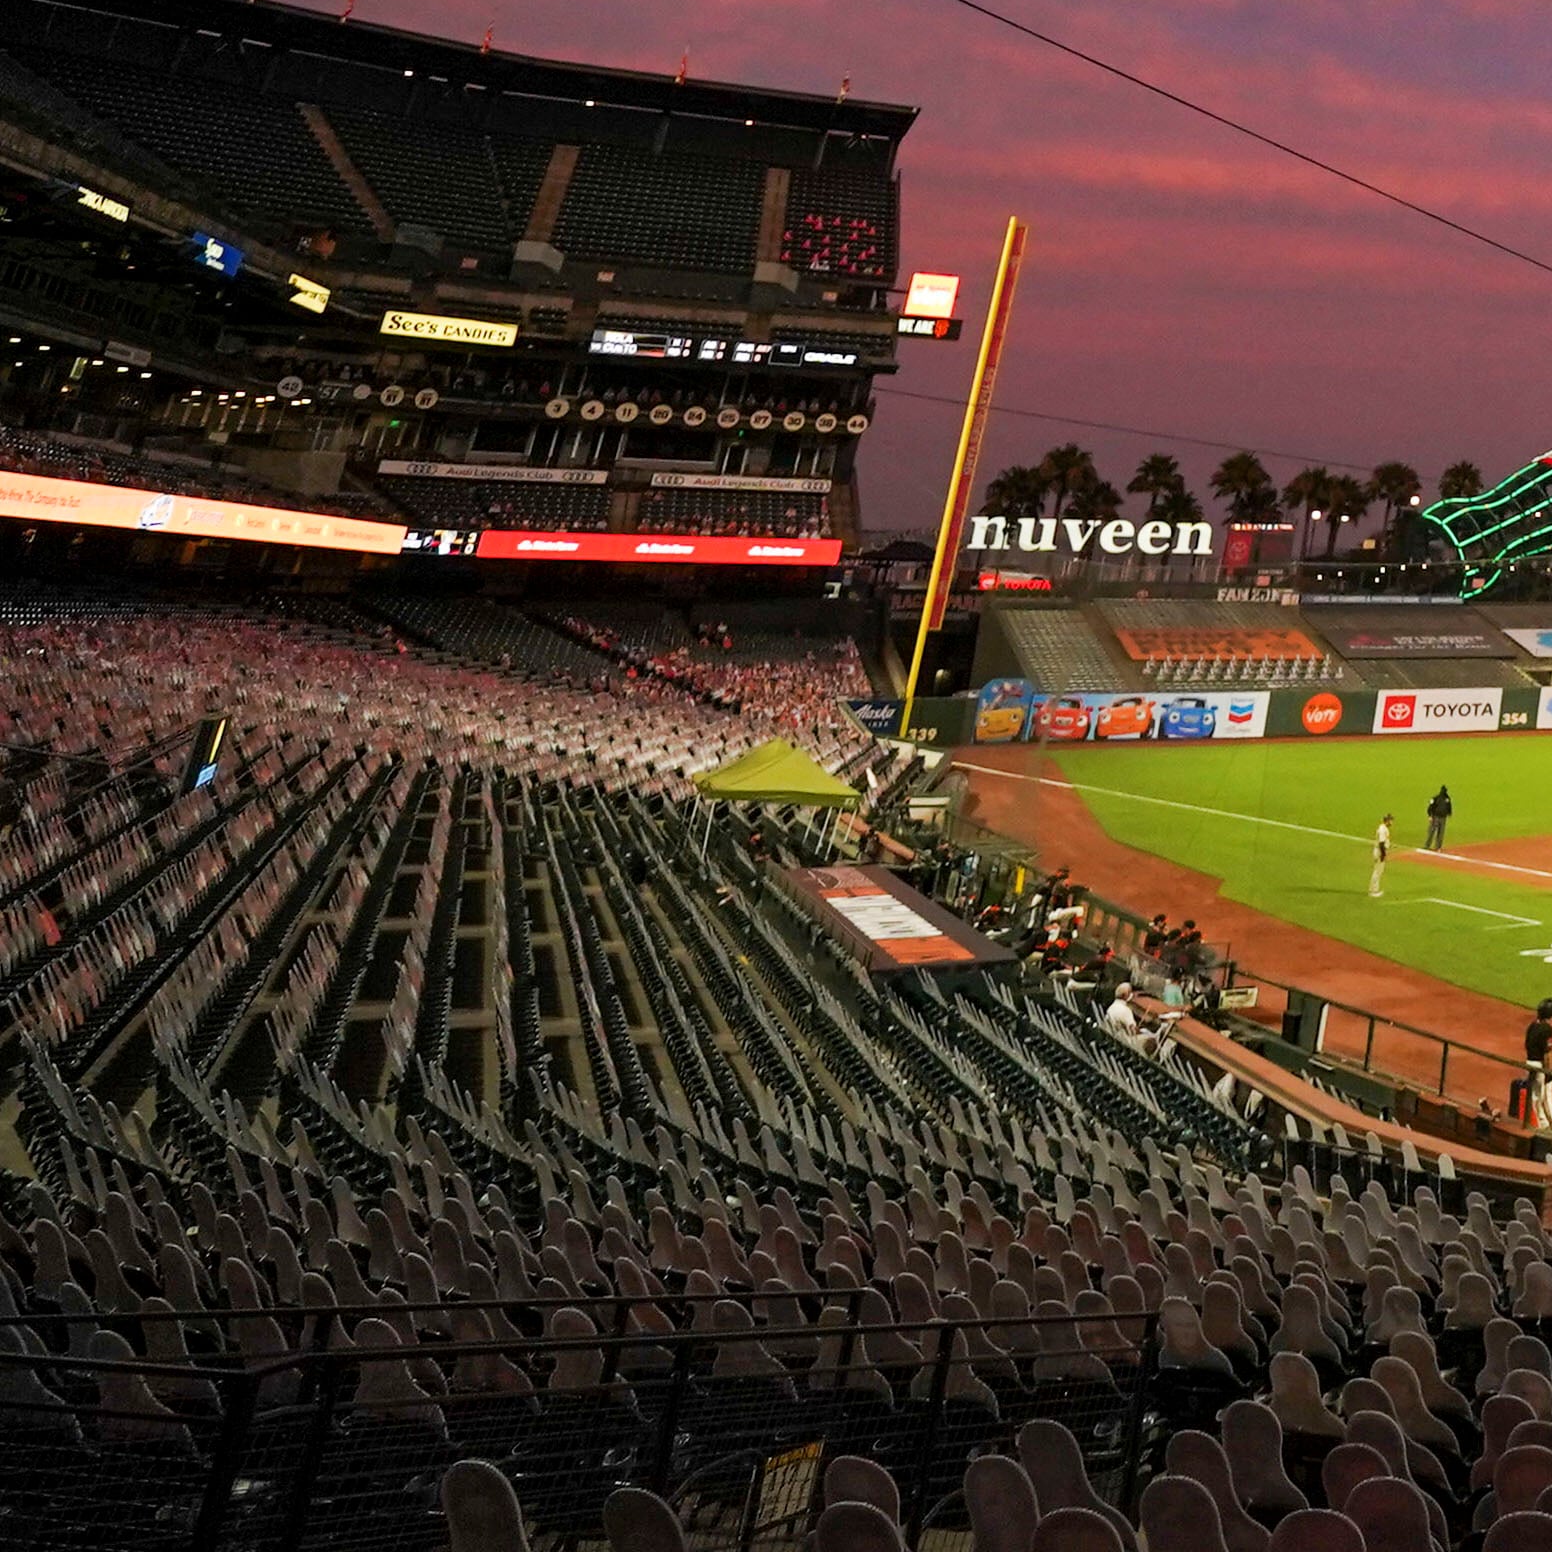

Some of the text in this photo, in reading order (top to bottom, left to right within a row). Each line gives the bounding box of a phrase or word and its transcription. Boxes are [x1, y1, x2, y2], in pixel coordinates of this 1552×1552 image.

[388, 314, 438, 334] See's
[967, 515, 1213, 555] nuveen
[1004, 579, 1051, 590] TOYOTA
[855, 704, 897, 720] Alaska
[1423, 703, 1493, 718] TOYOTA
[1502, 713, 1528, 726] 354
